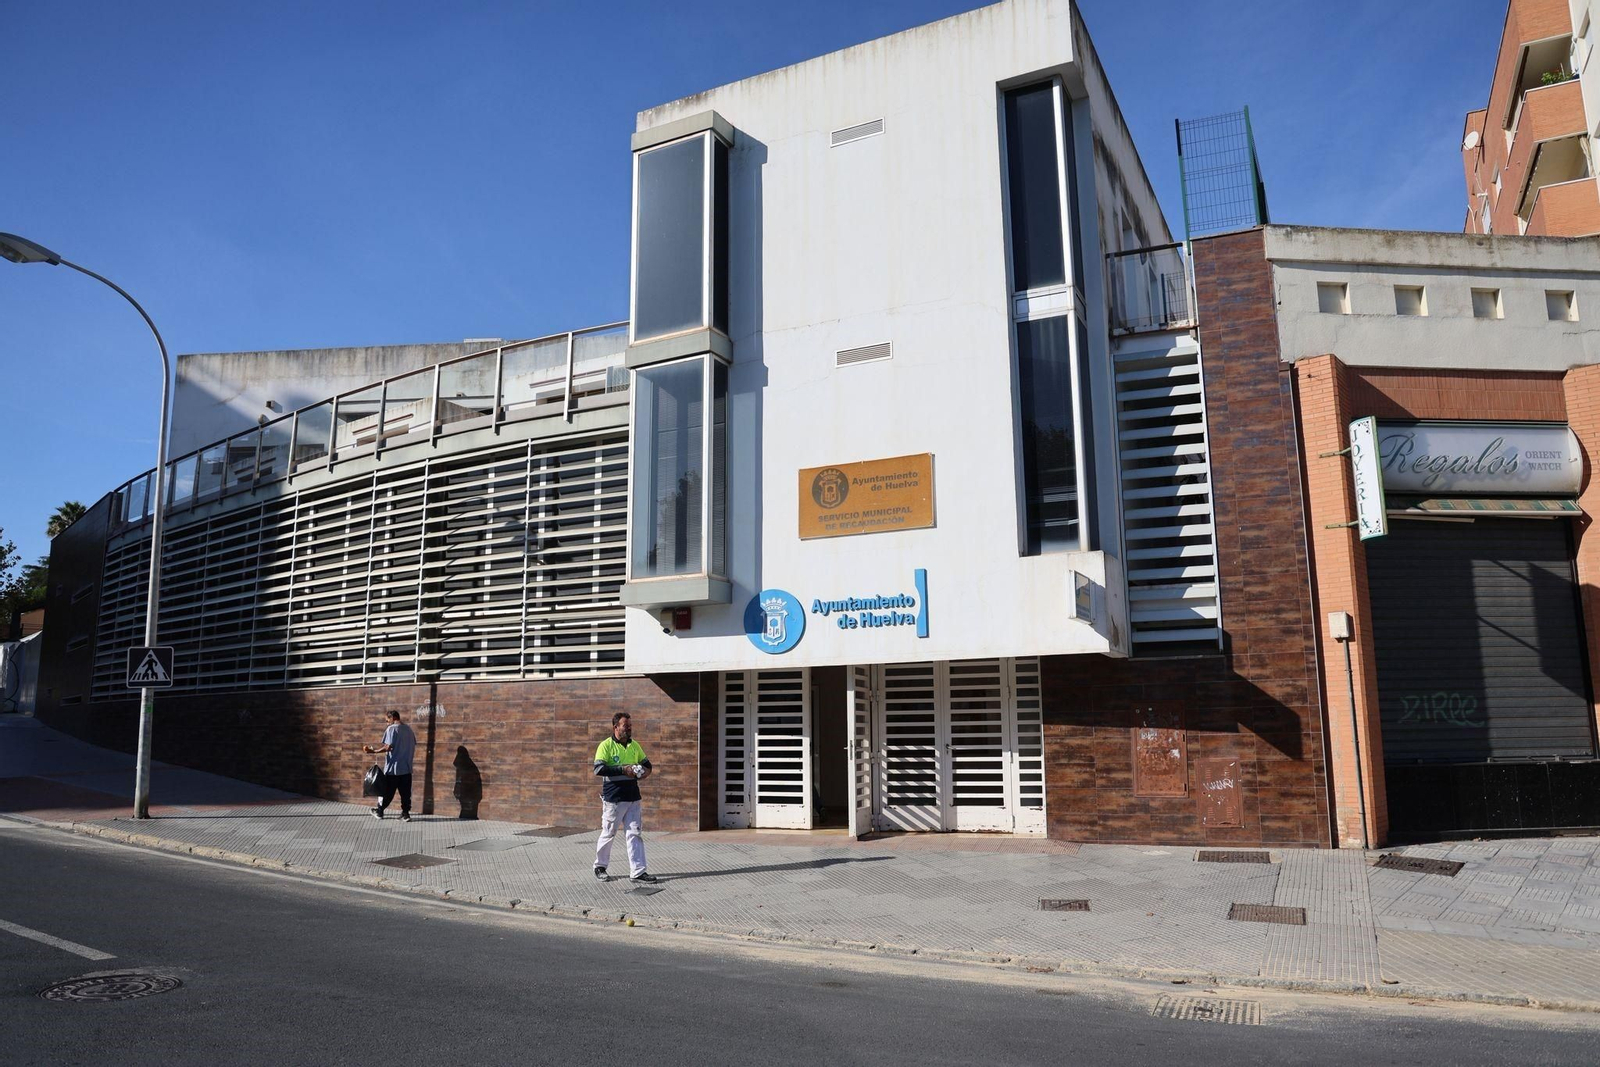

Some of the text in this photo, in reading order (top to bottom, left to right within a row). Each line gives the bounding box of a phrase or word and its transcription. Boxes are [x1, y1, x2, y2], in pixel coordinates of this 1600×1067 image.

[1380, 432, 1519, 488] Regalos
[1525, 450, 1562, 459] ORIENT
[1528, 462, 1562, 471] WATCH
[852, 470, 918, 487] Ayuntamiento
[871, 479, 919, 492] de Huelva
[1352, 429, 1371, 529] JOYERIA
[818, 506, 913, 523] SERVICIO MUNICIPAL
[825, 523, 837, 531] DE
[811, 592, 915, 616] Ayuntamiento
[837, 610, 916, 629] de Huelva
